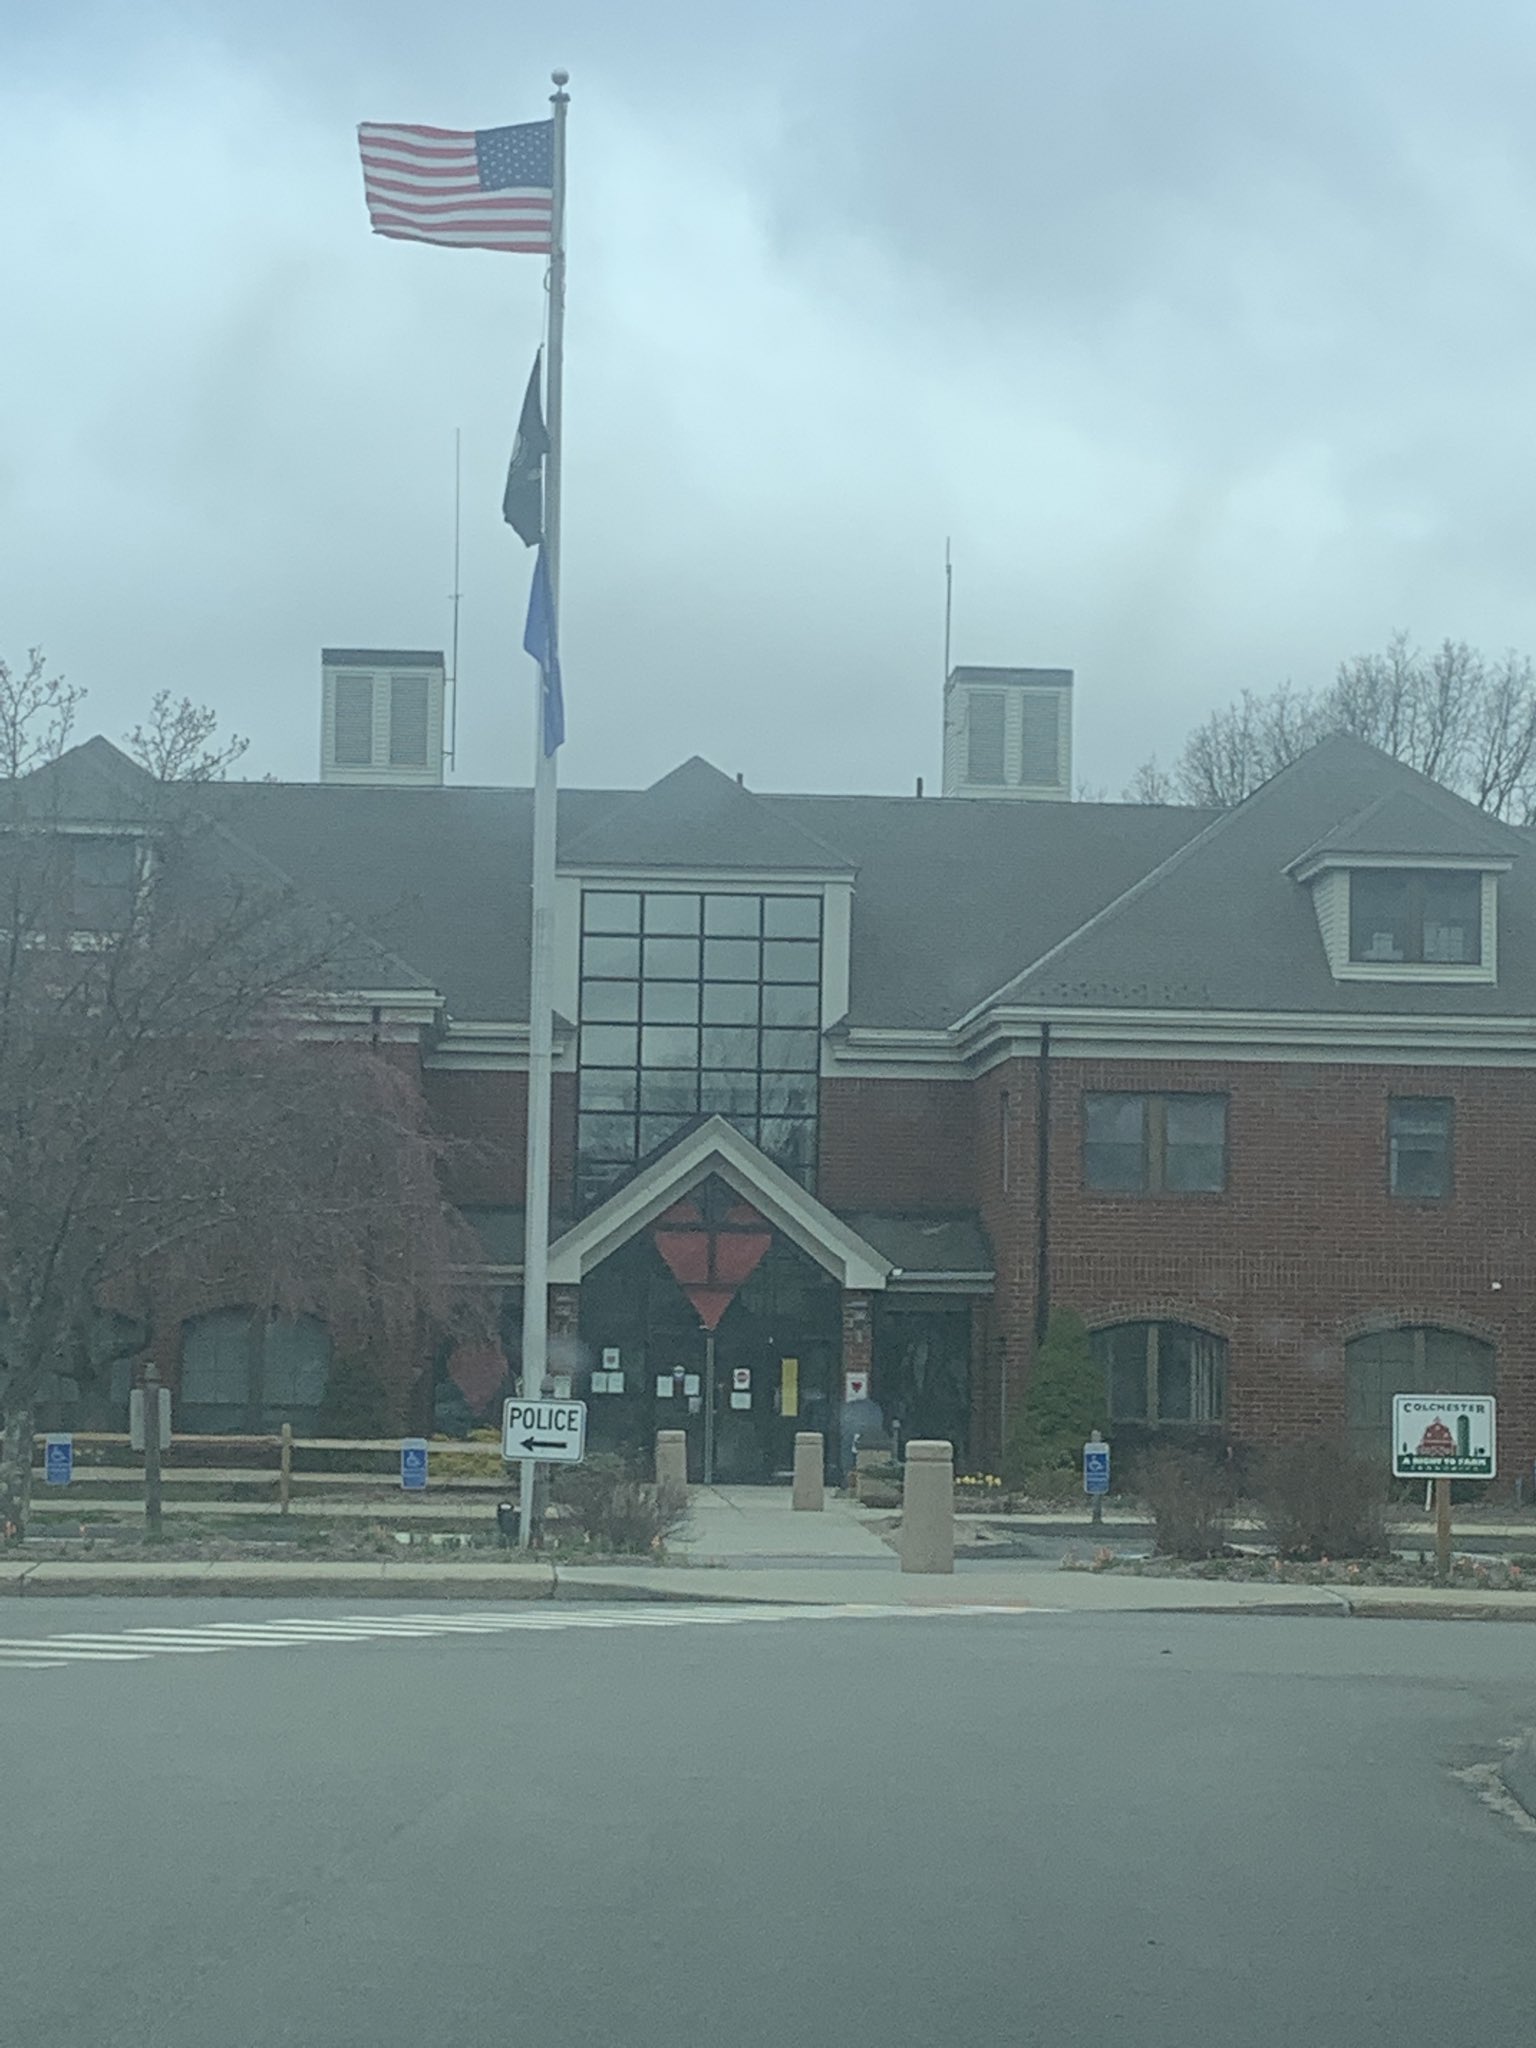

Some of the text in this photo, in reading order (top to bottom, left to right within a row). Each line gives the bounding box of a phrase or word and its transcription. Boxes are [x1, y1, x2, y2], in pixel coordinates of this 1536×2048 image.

[1404, 1403, 1485, 1413] COLCHESTER
[510, 1407, 578, 1431] POLICE
[1402, 1457, 1410, 1465] A
